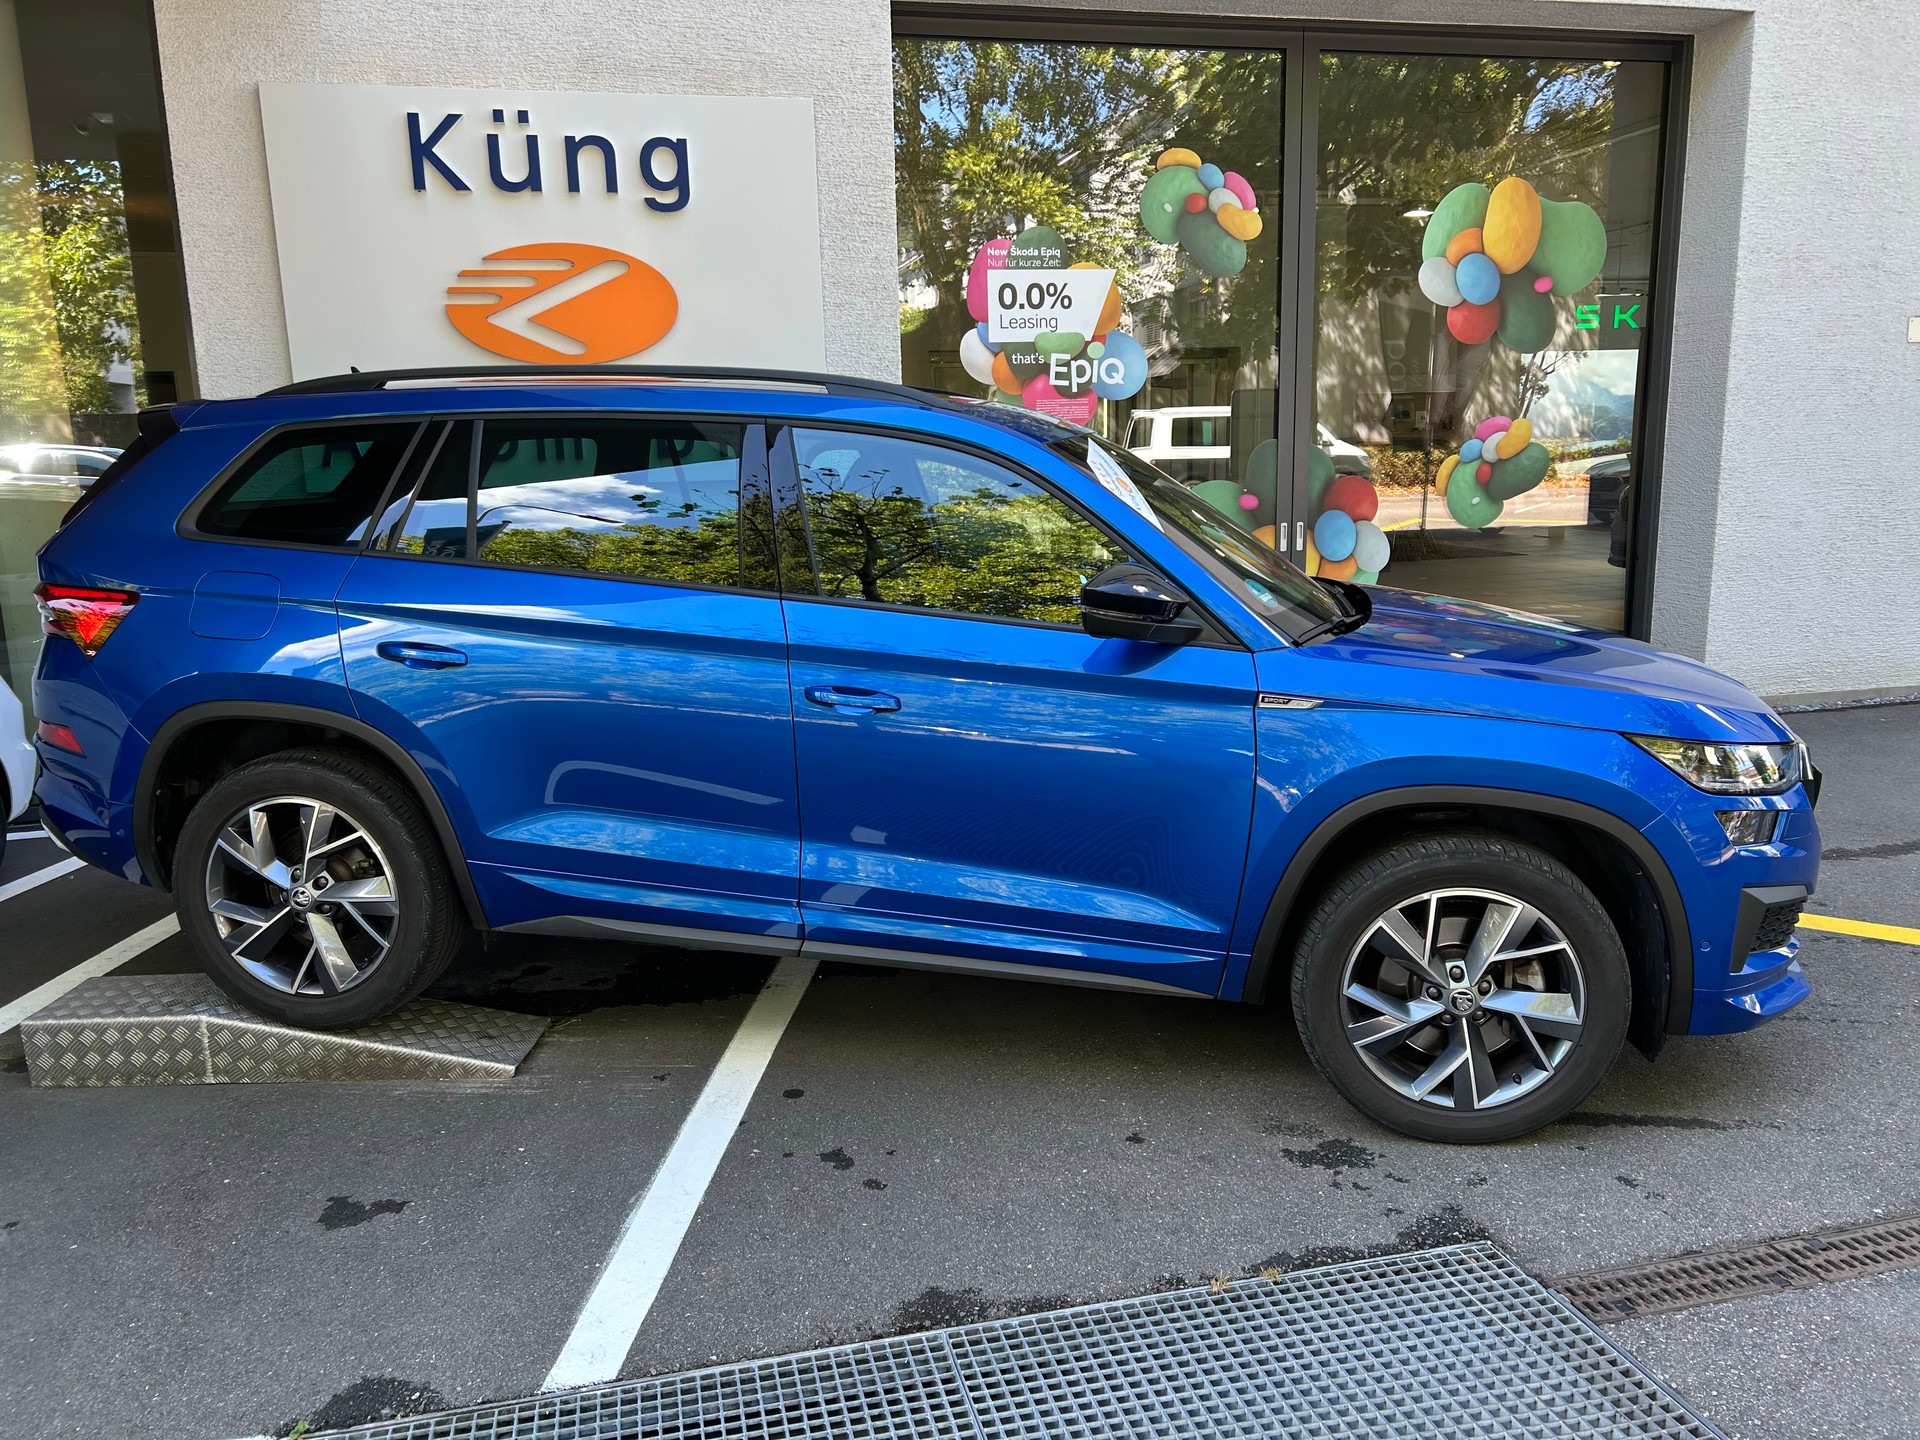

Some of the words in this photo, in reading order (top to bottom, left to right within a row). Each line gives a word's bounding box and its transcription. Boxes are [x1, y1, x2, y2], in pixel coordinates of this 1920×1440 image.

[406, 108, 691, 213] Küng
[987, 247, 1008, 256] New
[1010, 245, 1039, 256] Škoda
[1041, 247, 1061, 258] Epiq
[987, 258, 1004, 267] Nur
[1005, 258, 1018, 267] für
[1019, 258, 1042, 267] kurze
[998, 282, 1072, 310] 0.0%
[1000, 314, 1058, 333] Leasing
